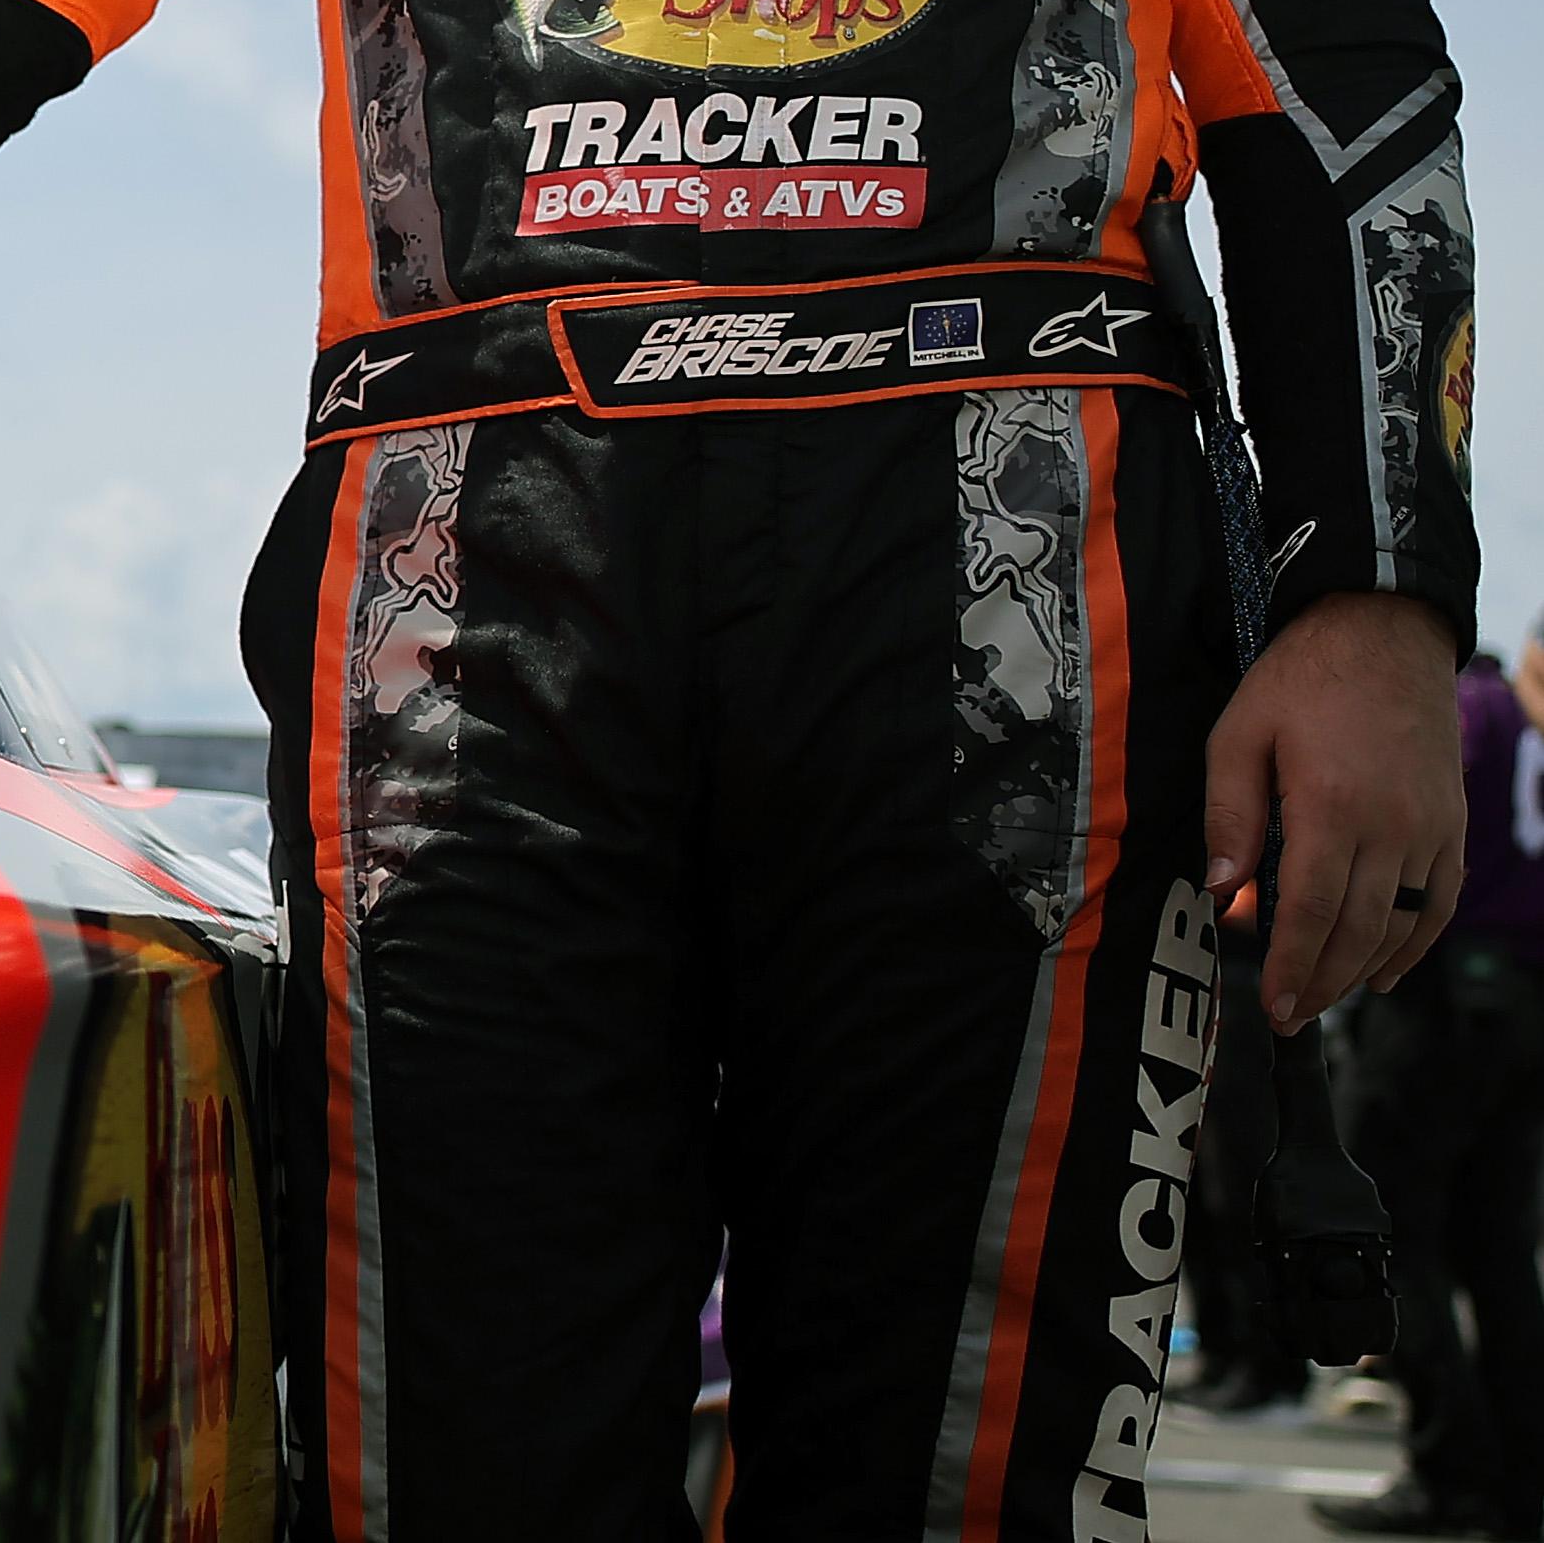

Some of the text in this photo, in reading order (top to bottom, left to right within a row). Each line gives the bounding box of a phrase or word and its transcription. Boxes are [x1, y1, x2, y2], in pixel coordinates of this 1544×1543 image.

[523, 92, 923, 173] TRACKER
[533, 176, 906, 224] BOATS & ATVs
[640, 311, 796, 346] CHASE
[967, 348, 980, 357] IN
[613, 326, 905, 385] BRISCOE
[1072, 877, 1216, 1543] TRACKER
